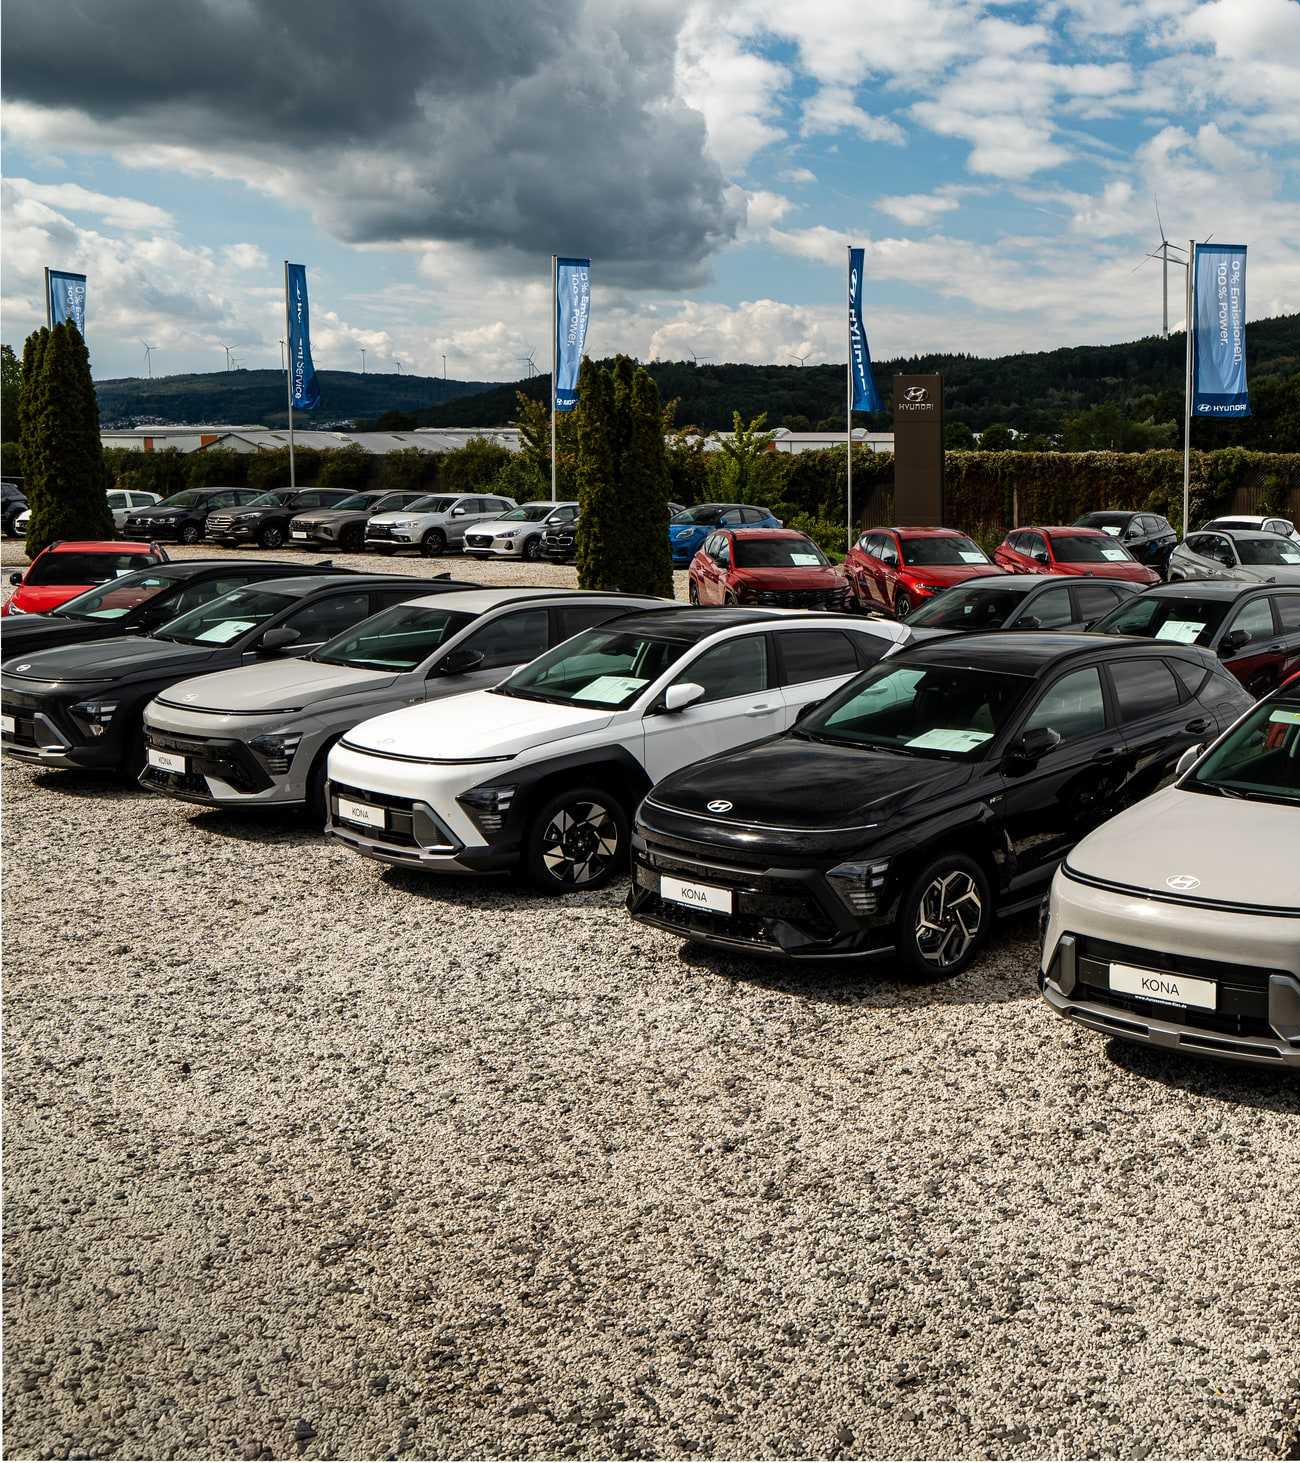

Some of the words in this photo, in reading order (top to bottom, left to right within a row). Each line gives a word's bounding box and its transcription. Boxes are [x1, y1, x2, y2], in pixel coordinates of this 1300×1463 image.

[567, 308, 581, 347] Power.
[1218, 304, 1229, 347] Power.
[1230, 288, 1242, 366] Emissionen.
[294, 361, 305, 399] Service
[899, 403, 934, 411] HYUNDAI
[1213, 404, 1247, 412] HYUNDAI
[352, 807, 369, 819] KONA
[681, 887, 707, 902] KONA
[1141, 977, 1180, 996] KONA
